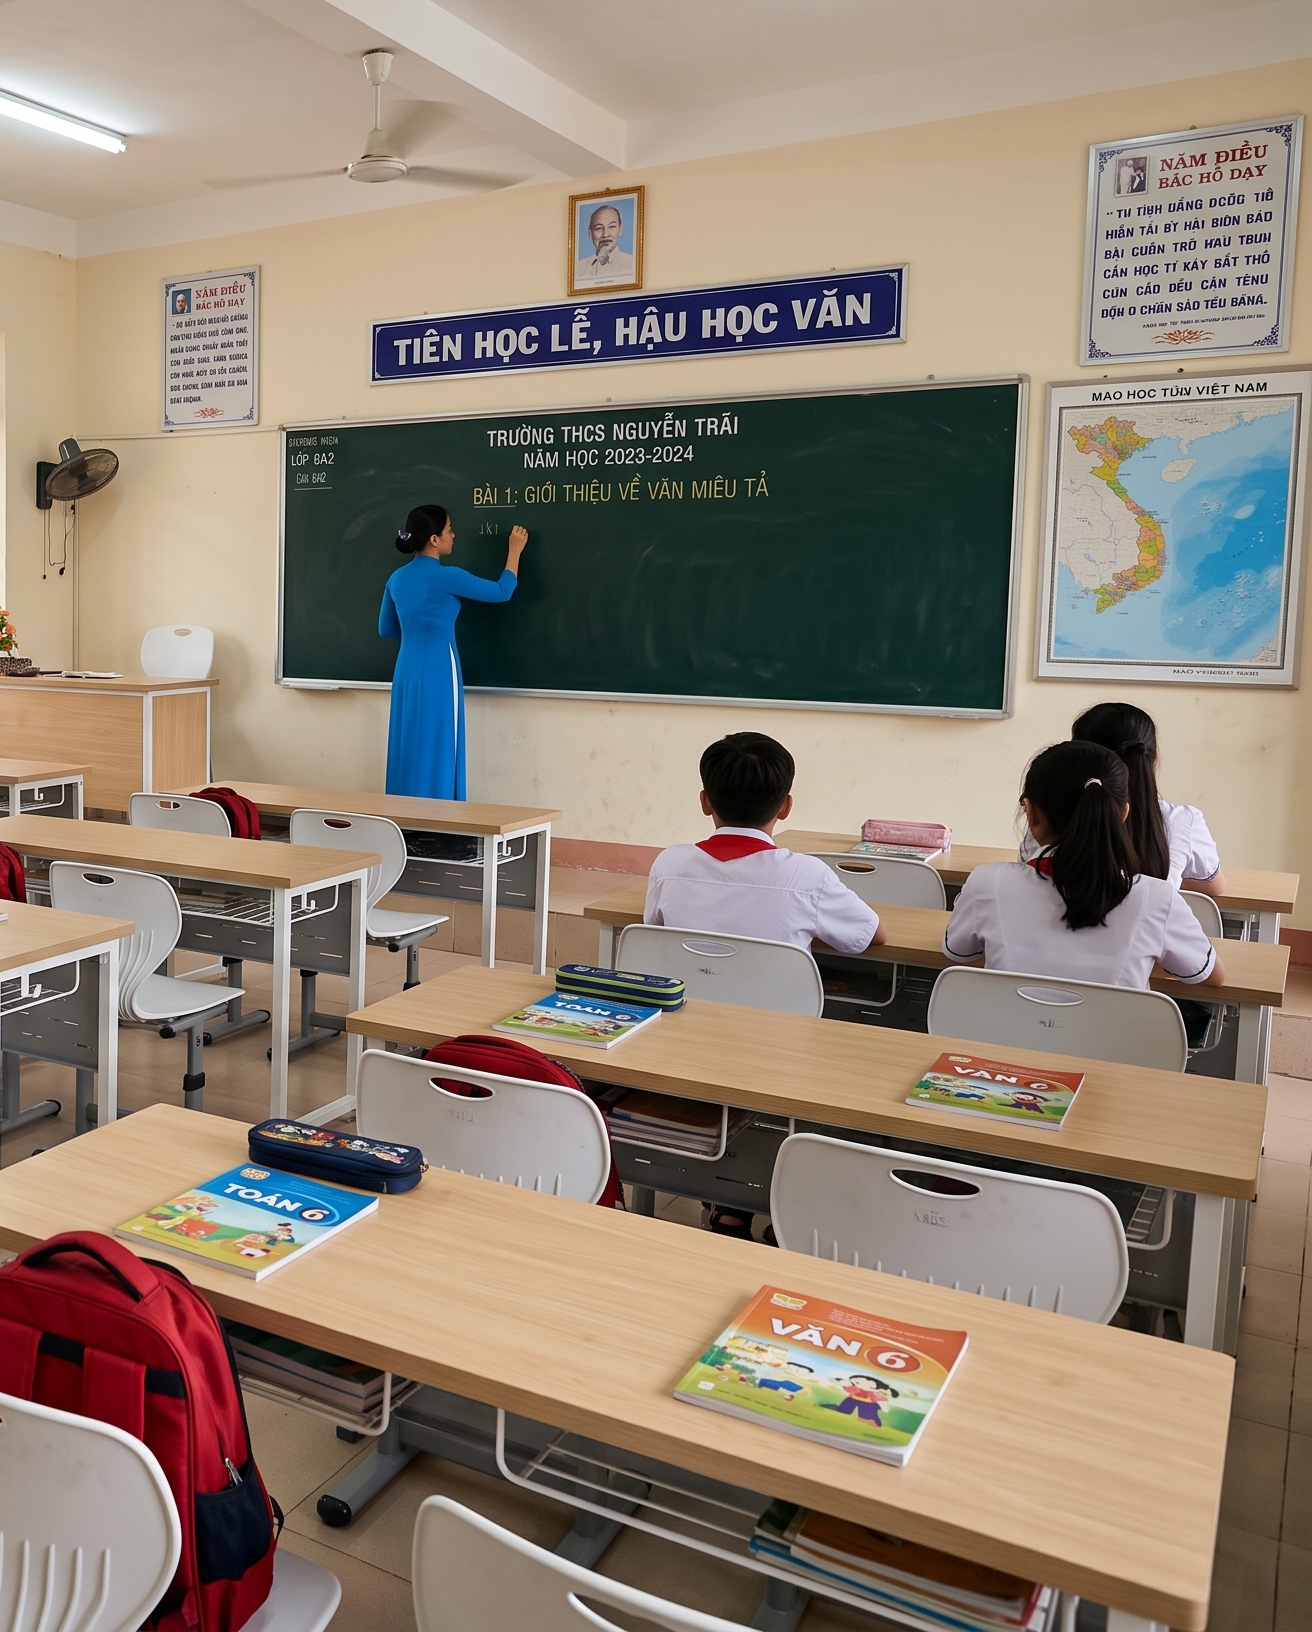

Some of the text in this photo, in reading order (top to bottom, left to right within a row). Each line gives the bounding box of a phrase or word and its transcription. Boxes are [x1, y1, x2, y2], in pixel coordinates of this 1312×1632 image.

[1158, 173, 1192, 189] BÁC
[1229, 164, 1267, 180] DẠY
[1160, 152, 1207, 172] NĂM
[393, 288, 871, 366] TIÊN HỌC LỄ, HẬU HỌC VĂN
[1092, 391, 1122, 402] MAO
[1196, 383, 1230, 396] VIỆT
[1235, 382, 1268, 393] NAM
[487, 412, 738, 448] TRƯỜNG THCS NGUYỄN TRÃI
[566, 449, 598, 470] HỌC
[604, 445, 694, 466] 2023-2024
[474, 470, 769, 505] BÀI 1: GIỚI THIỆU VỀ VĂN MIÊU TẢ
[224, 1182, 303, 1212] TOÁN
[302, 1208, 330, 1221] 6
[771, 1318, 862, 1357] VĂN
[876, 1352, 910, 1369] 6
